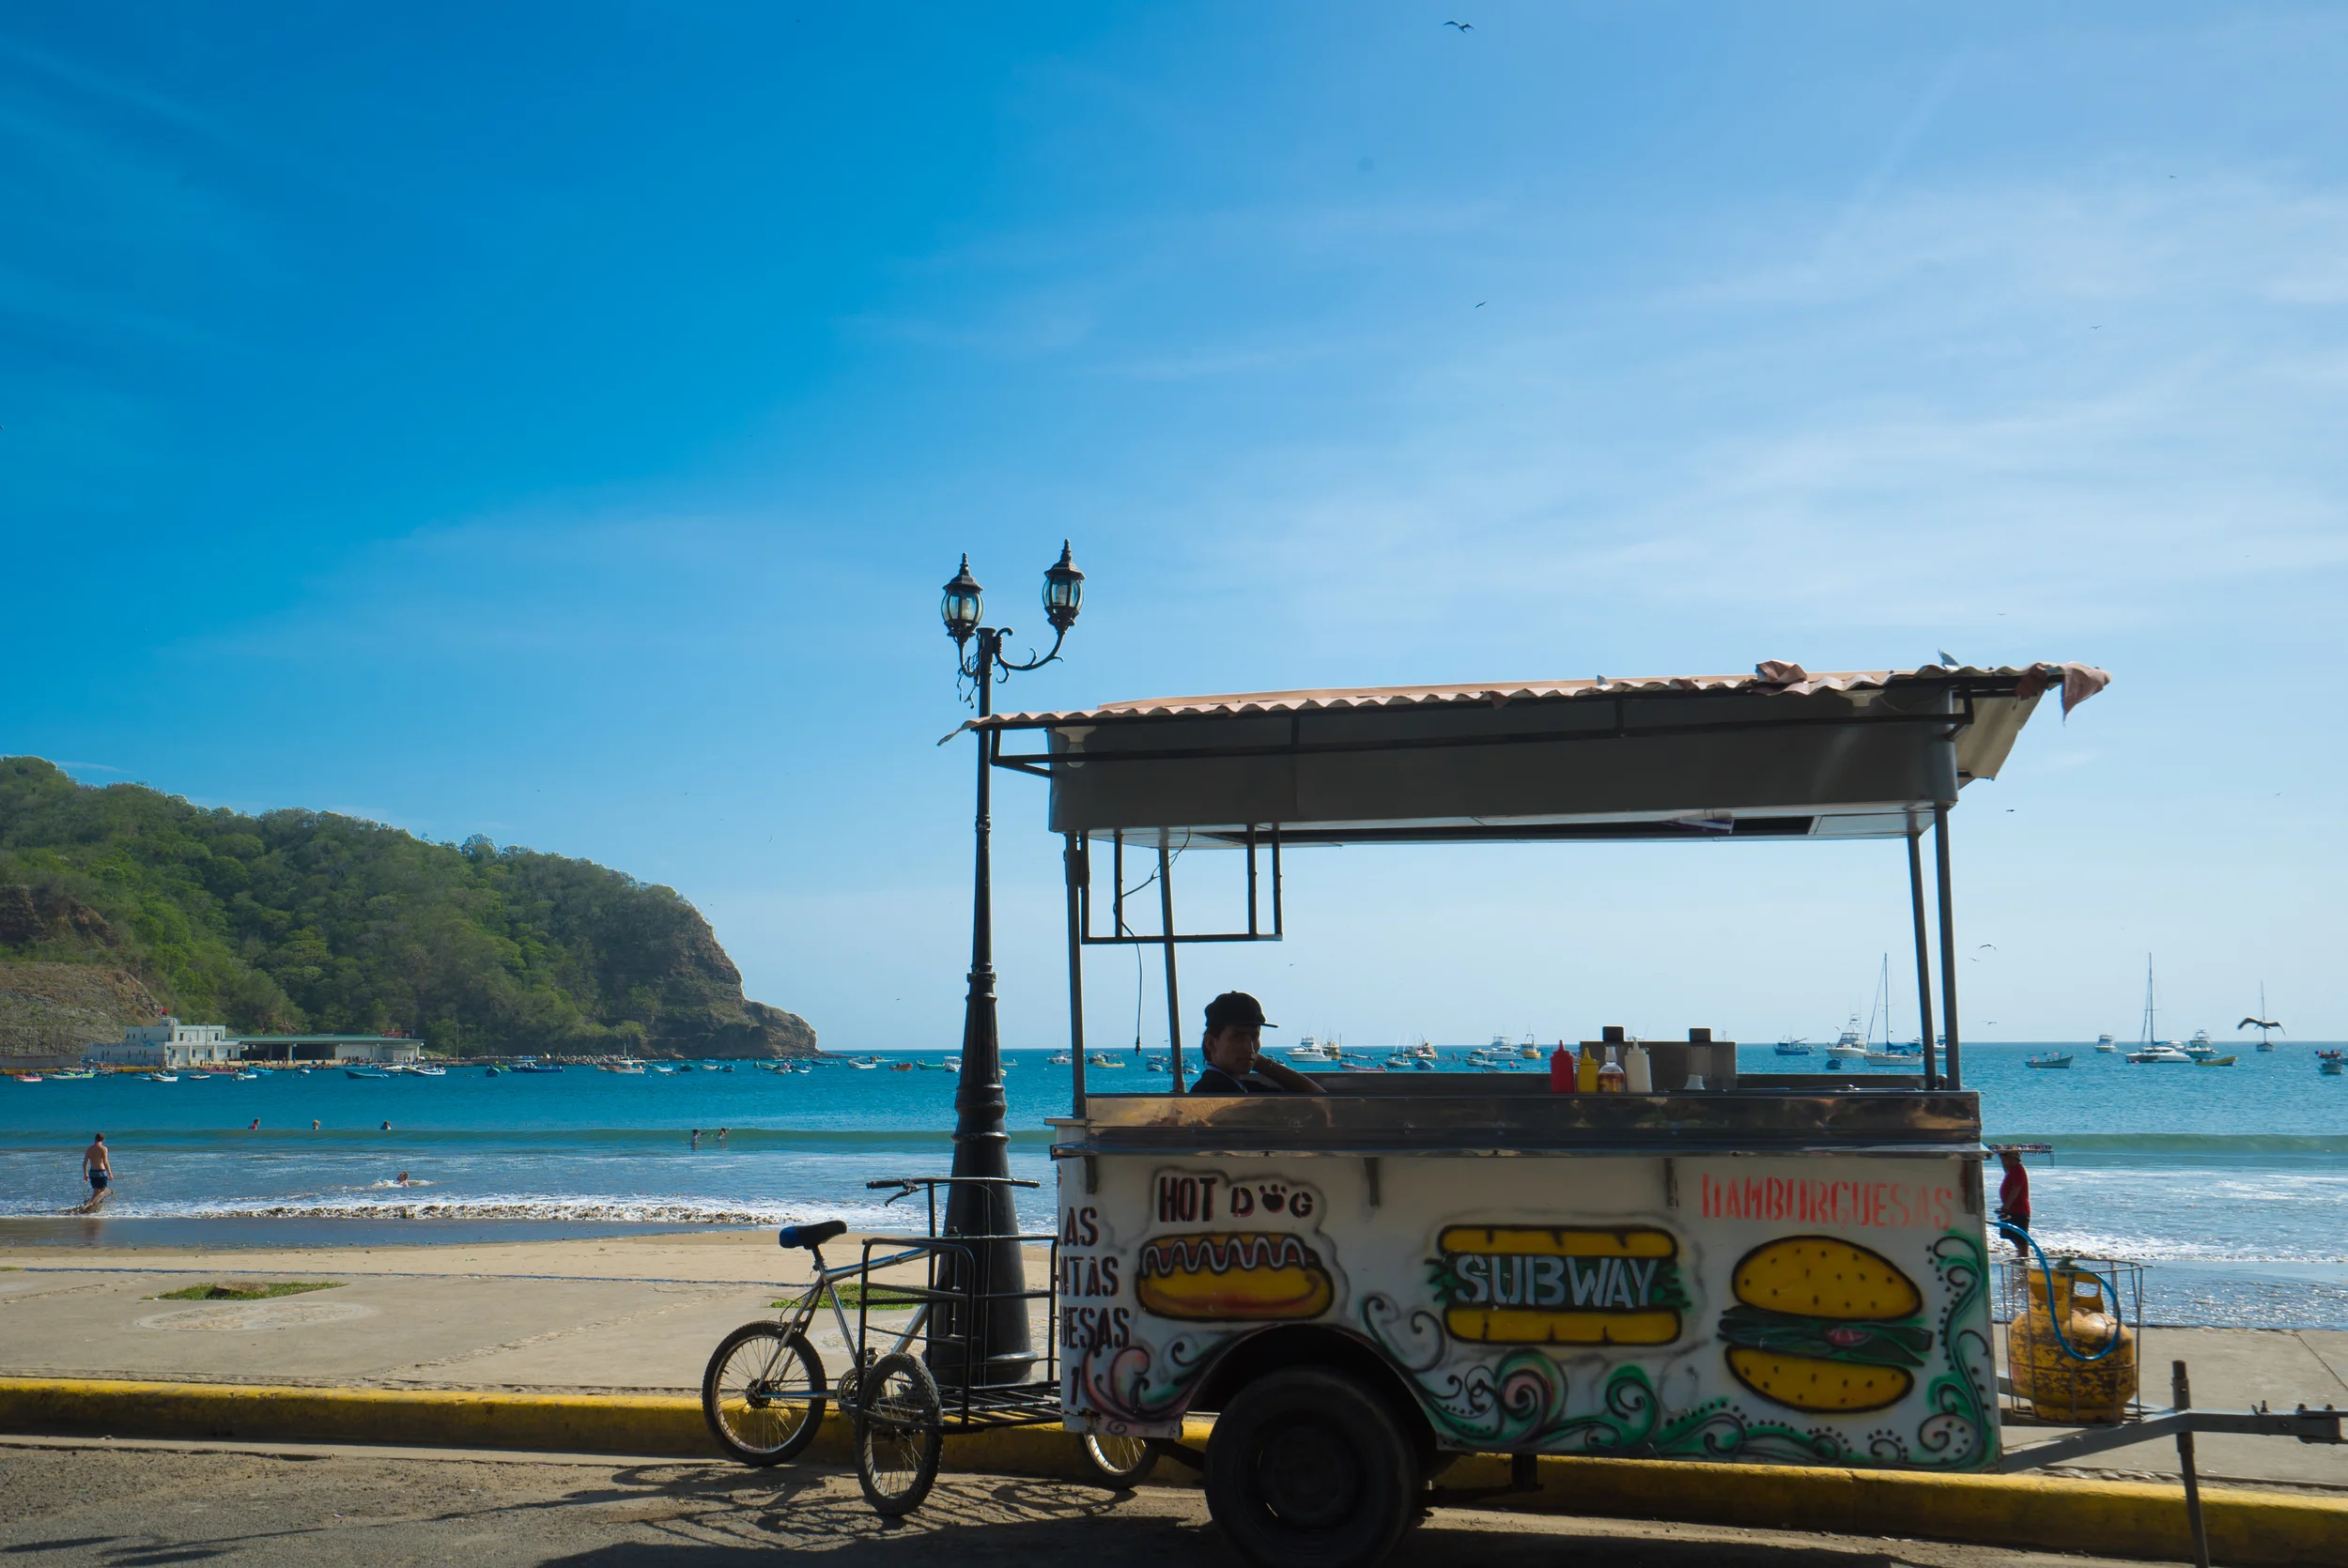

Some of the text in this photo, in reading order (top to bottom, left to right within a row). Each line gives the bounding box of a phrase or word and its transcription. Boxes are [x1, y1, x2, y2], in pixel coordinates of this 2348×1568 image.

[1158, 1176, 1218, 1222] HOT
[1702, 1174, 1953, 1231] HAMBURGUESAS
[1456, 1254, 1658, 1308] SUBWAY
